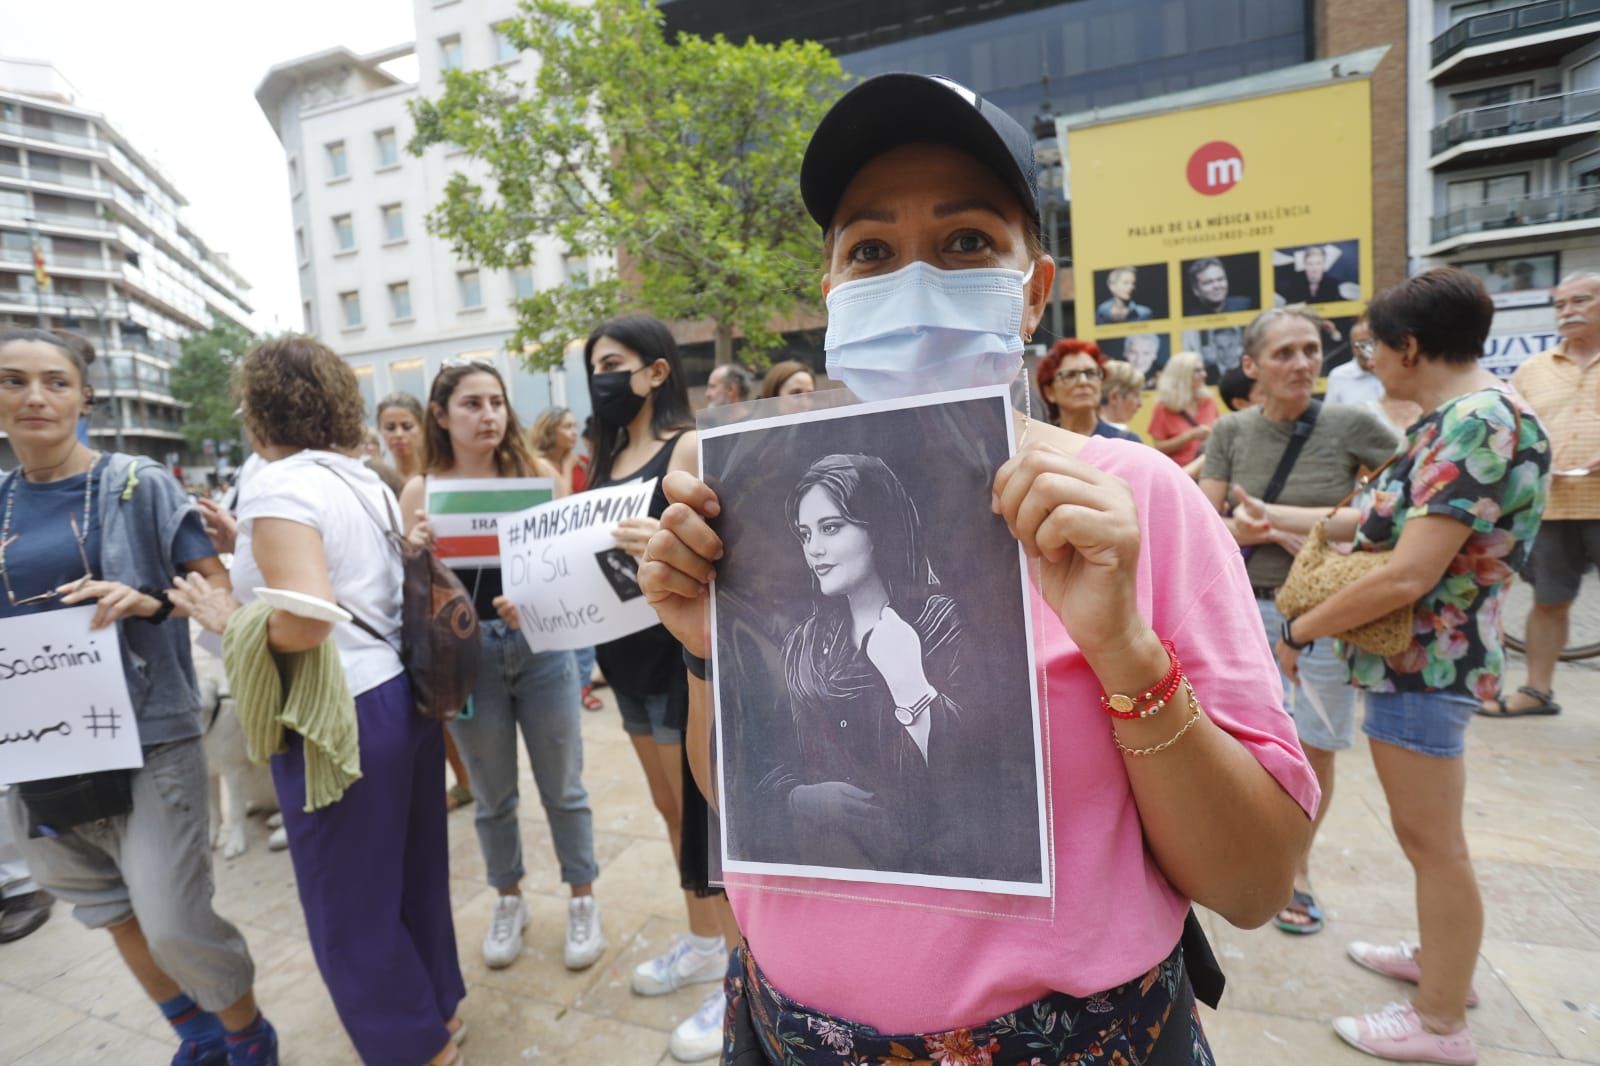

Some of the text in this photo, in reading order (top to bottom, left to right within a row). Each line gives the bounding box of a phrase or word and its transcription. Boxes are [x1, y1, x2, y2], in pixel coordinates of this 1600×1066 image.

[1127, 224, 1163, 238] PALAU
[1167, 221, 1183, 233] DE
[1186, 219, 1202, 230] LA
[508, 492, 646, 544] #MAHSAAMINI
[518, 598, 605, 634] Nombre
